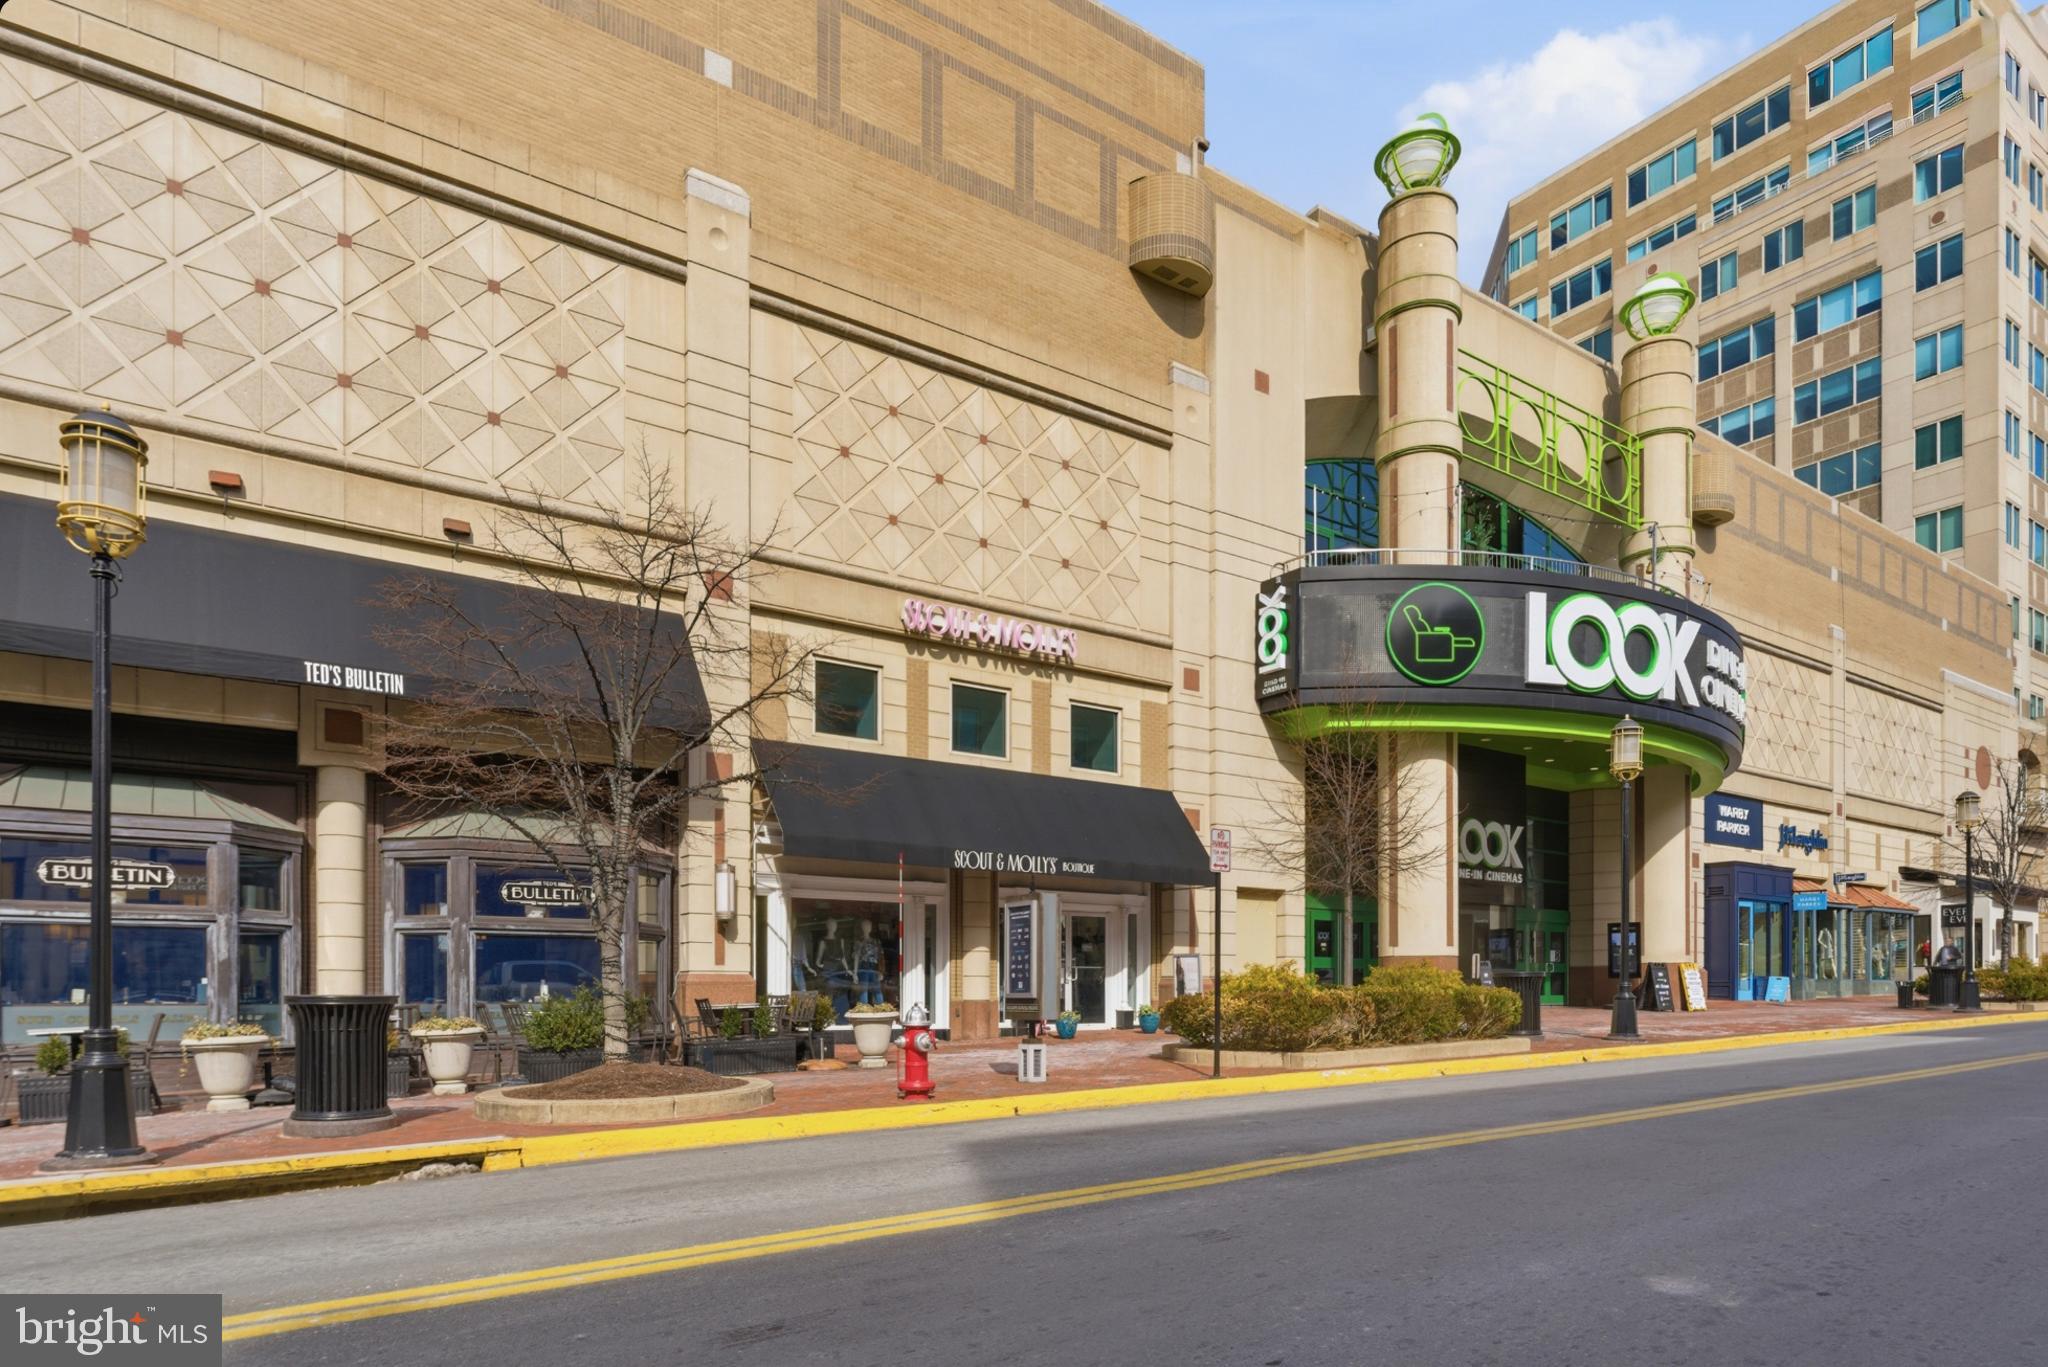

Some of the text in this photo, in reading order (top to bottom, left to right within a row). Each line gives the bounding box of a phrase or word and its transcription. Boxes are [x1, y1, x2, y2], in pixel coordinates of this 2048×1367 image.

[904, 598, 971, 640] SCOUT
[976, 612, 994, 644] &
[1258, 584, 1288, 674] LOOK
[1525, 590, 1702, 709] LOOK
[304, 660, 404, 696] TED'S BULLETIN
[1718, 804, 1749, 820] WARBY
[1458, 818, 1524, 869] OOK
[1716, 820, 1751, 836] PARKER
[52, 864, 162, 883] BUETIN
[954, 849, 1096, 875] SCOUT & MOLLY'S BOUTIQUE
[1485, 870, 1524, 884] CINEMAS
